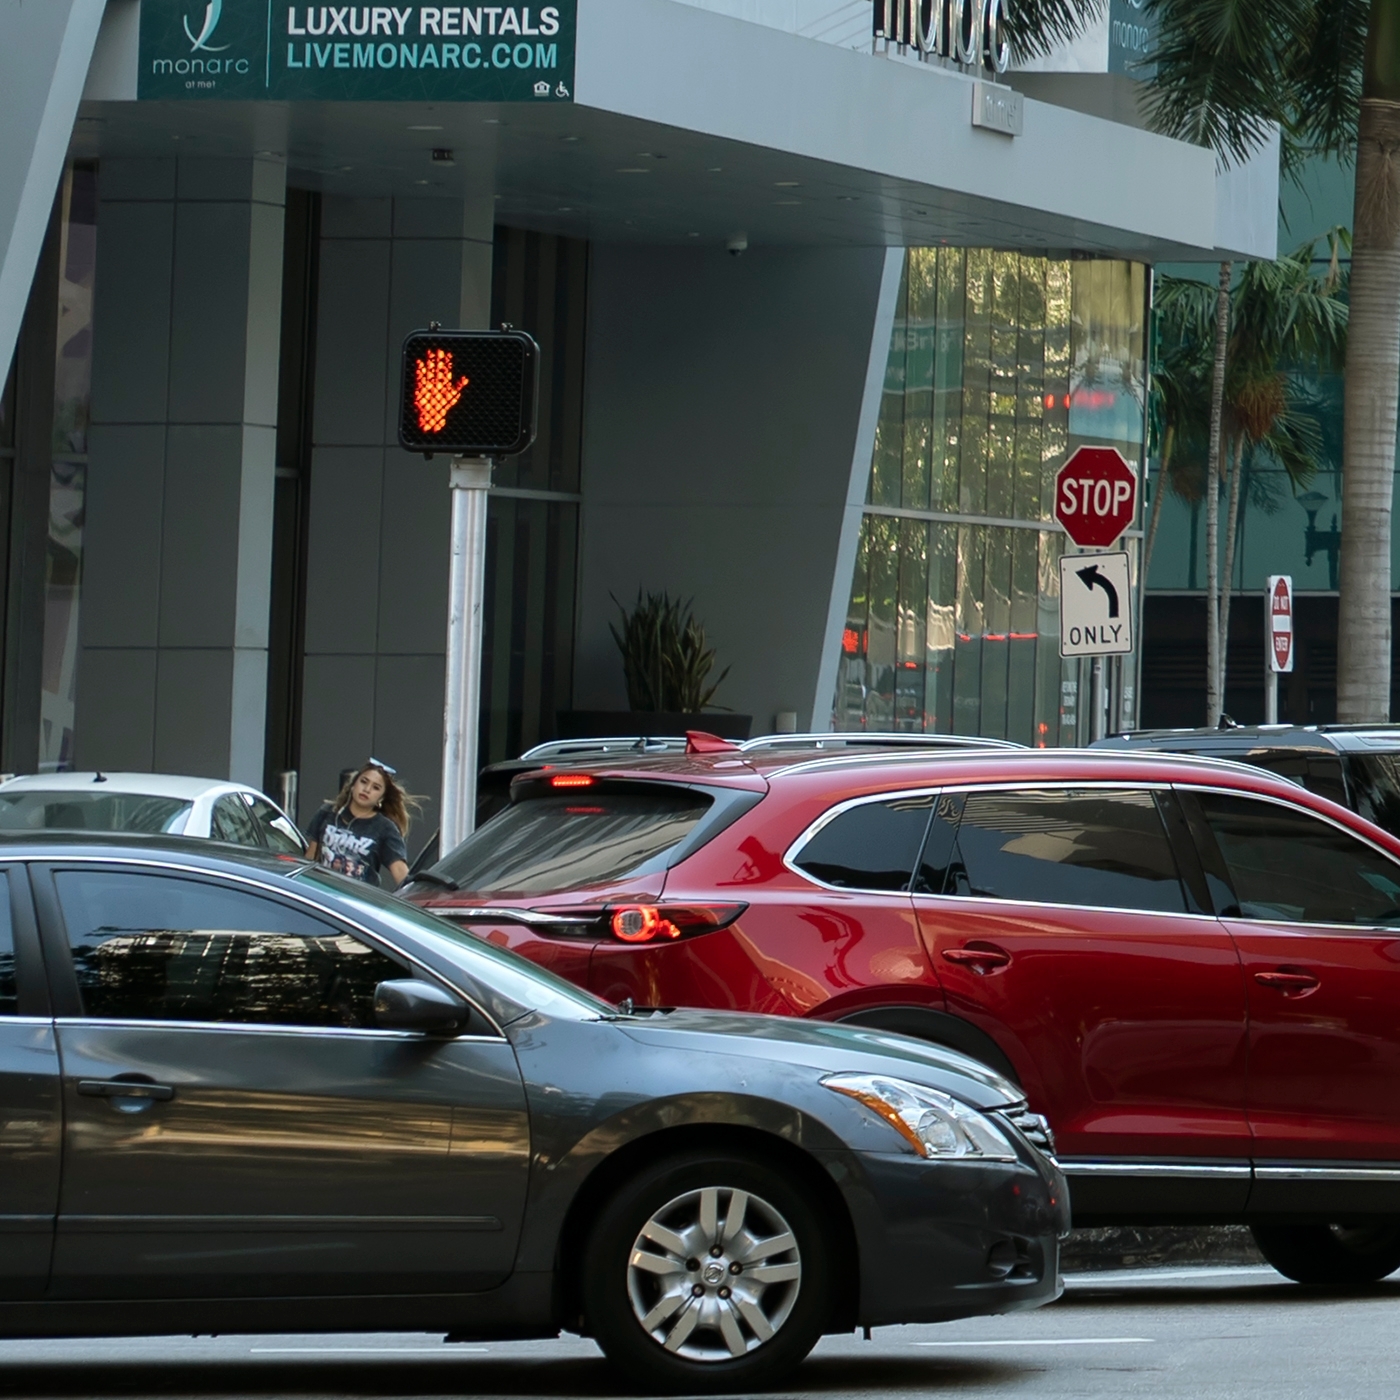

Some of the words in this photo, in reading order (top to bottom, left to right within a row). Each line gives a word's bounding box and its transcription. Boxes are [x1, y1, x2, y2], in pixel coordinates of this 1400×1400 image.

[287, 6, 413, 36] LUXURY
[420, 6, 560, 36] RENTALS
[152, 58, 250, 75] monarc
[286, 42, 558, 69] LIVEMONARC.COM
[1060, 477, 1131, 517] STOP
[1069, 624, 1122, 646] ONLY
